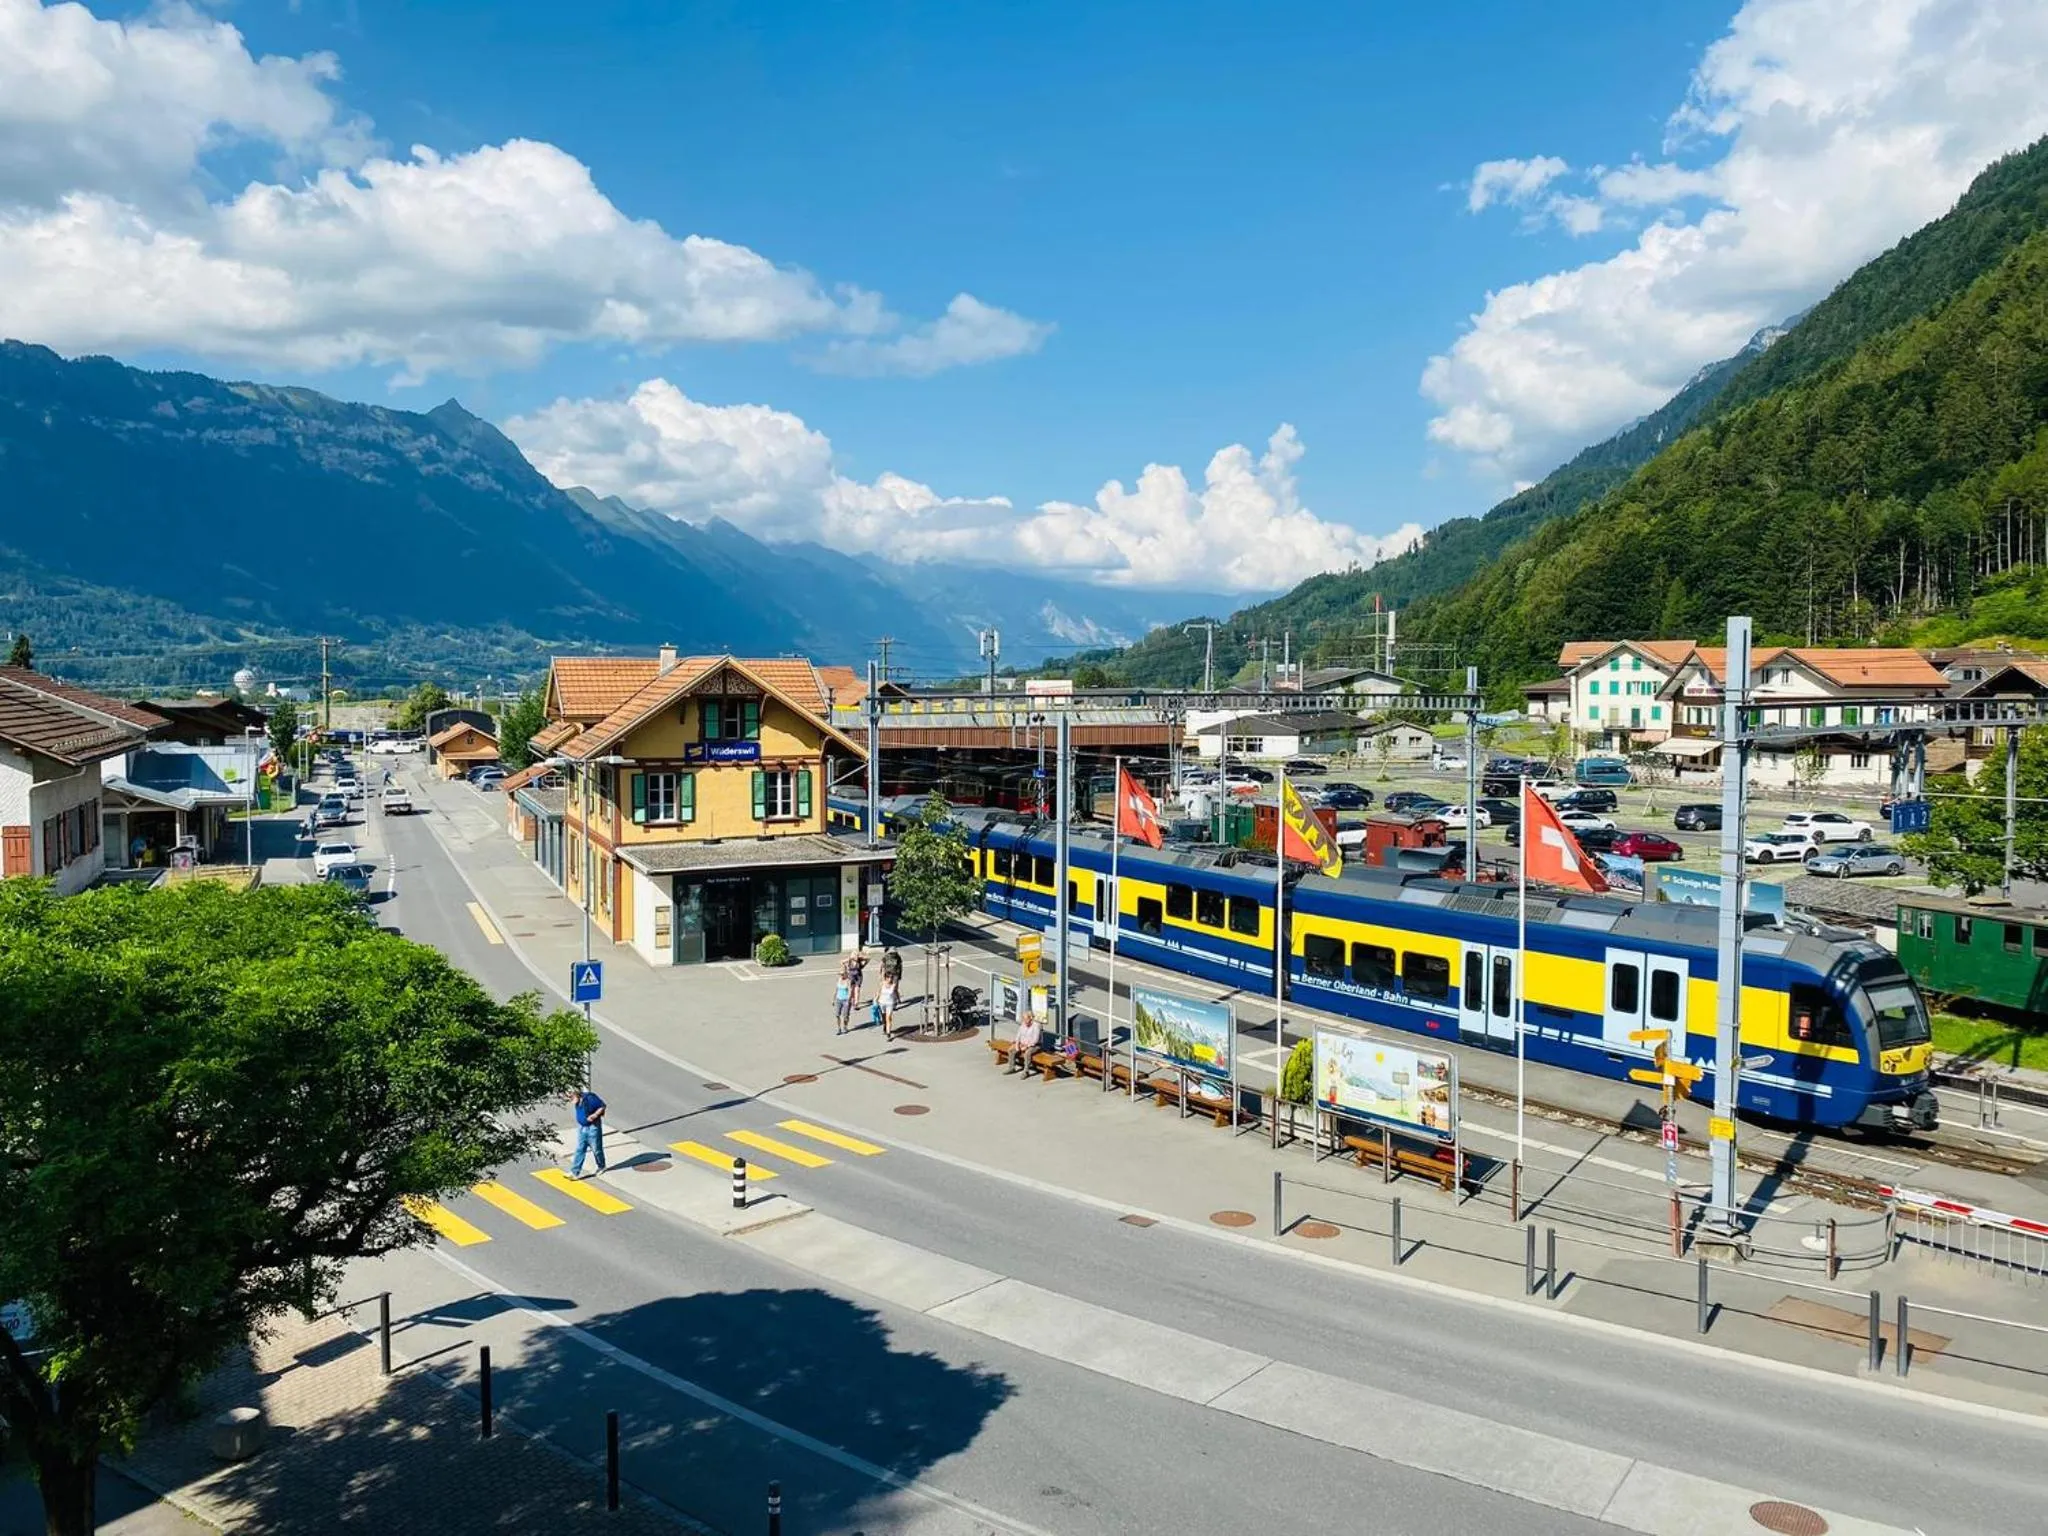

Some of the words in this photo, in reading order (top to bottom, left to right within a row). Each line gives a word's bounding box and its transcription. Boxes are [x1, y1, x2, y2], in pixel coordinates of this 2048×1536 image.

[710, 747, 754, 755] Wilderswil
[1301, 973, 1332, 987] Berner
[1333, 981, 1377, 998] Oberland
[1383, 990, 1409, 1004] Bahn
